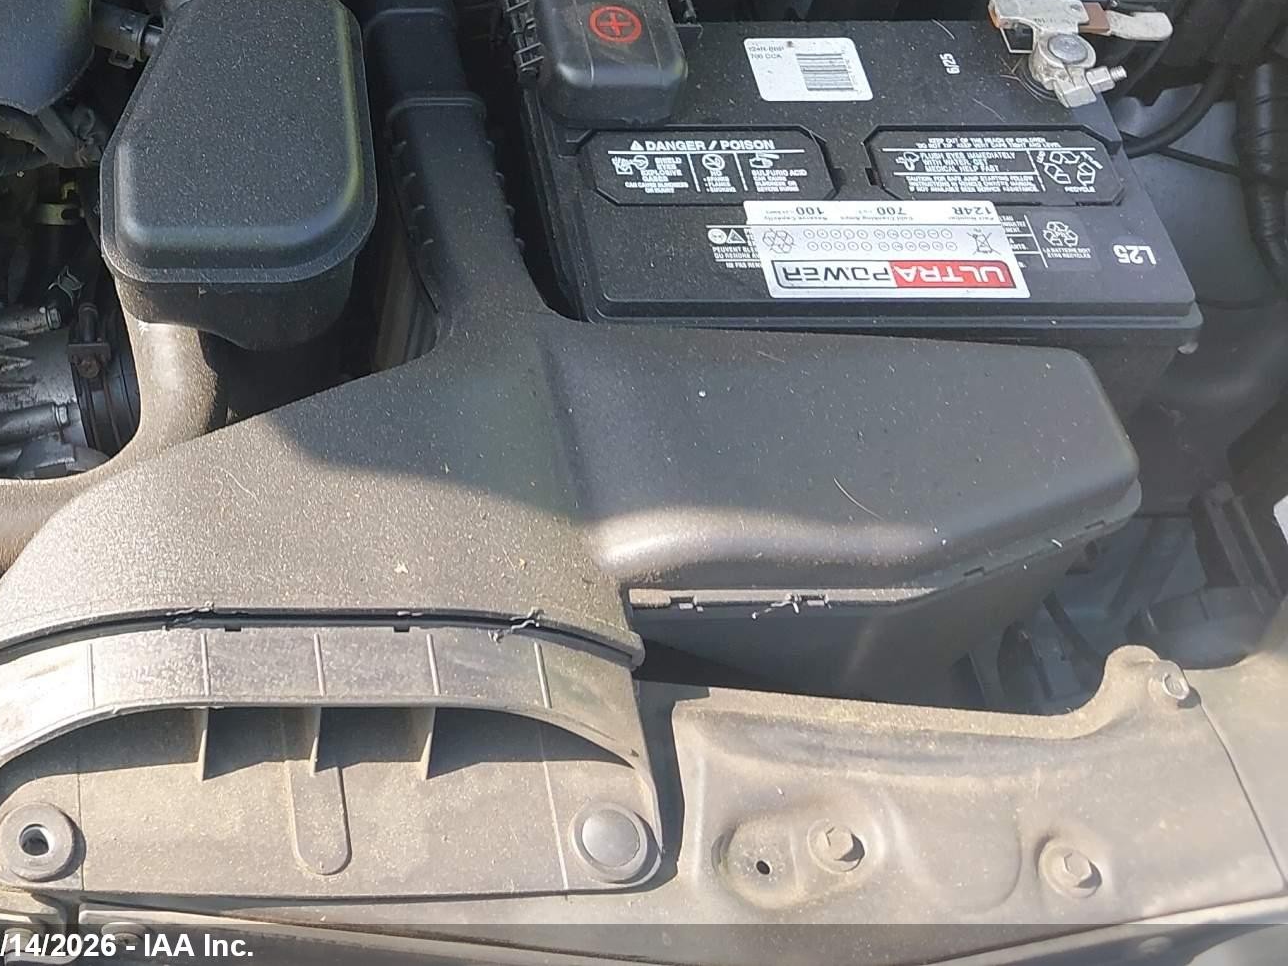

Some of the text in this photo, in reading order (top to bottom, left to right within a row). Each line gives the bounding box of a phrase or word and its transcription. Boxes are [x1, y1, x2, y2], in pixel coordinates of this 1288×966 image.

[645, 140, 776, 151] DANGER / POISON
[796, 206, 825, 215] 100
[876, 206, 907, 215] 700
[952, 206, 993, 215] 124R
[1113, 245, 1157, 265] L25
